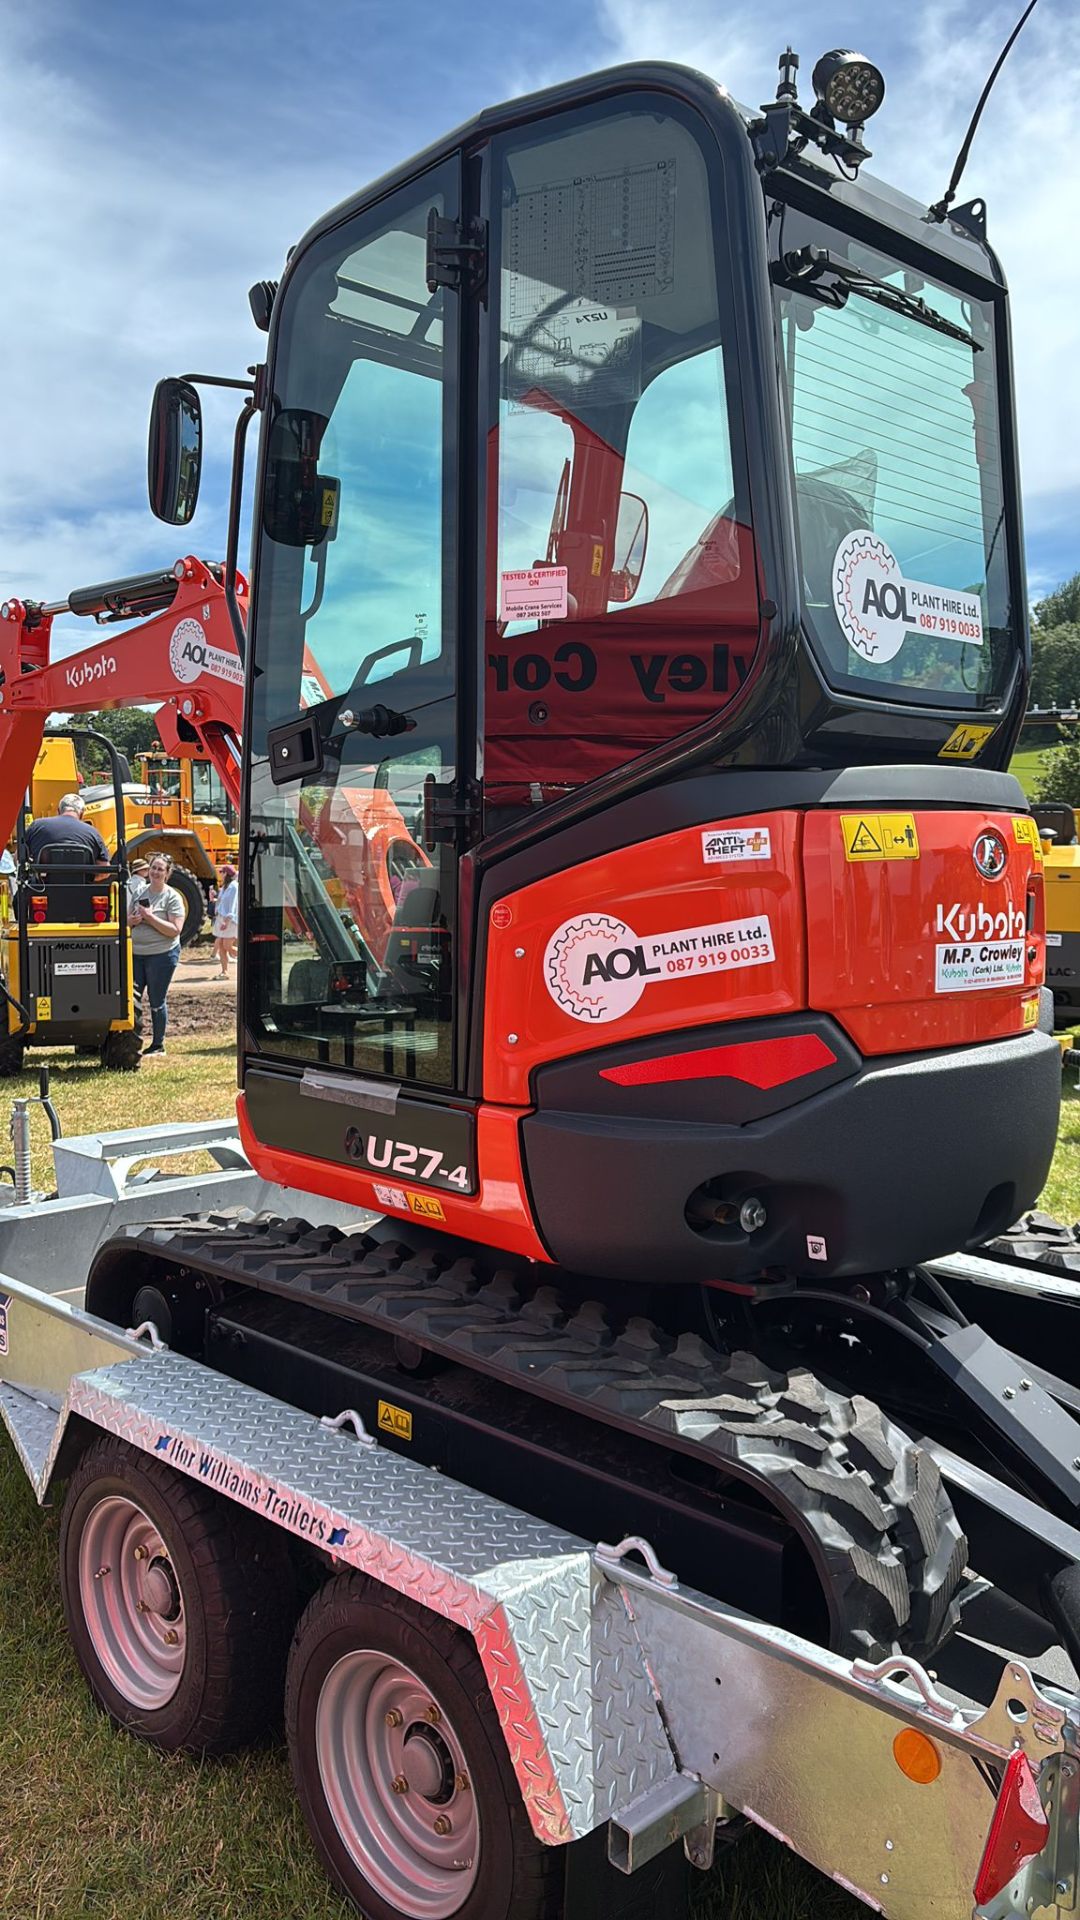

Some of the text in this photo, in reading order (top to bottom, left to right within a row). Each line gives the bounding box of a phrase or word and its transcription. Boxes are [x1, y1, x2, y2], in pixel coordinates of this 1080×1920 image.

[502, 569, 567, 581] TESTED & CERTIFIED
[528, 579, 539, 587] ON
[505, 602, 562, 612] Mobile Crane Services
[862, 578, 916, 624] AOL
[911, 591, 979, 618] PLANT HIRE Ltd.
[920, 613, 981, 638] 087 919 0033
[182, 642, 209, 668] AOL
[208, 651, 226, 664] PLANT
[225, 658, 238, 669] HIRE
[66, 654, 117, 688] Kubota
[210, 663, 245, 682] 087 919 003
[705, 836, 737, 848] ANTI
[705, 844, 746, 856] THEFT
[936, 901, 1026, 942] Kubota
[652, 926, 768, 957] PLANT HIRE Ltd.
[943, 944, 1023, 964] M.P. Crowley
[582, 945, 662, 986] AOL
[666, 944, 771, 973] 087 919 0033
[942, 967, 968, 978] Kubota
[972, 965, 992, 976] (Cork)
[1046, 967, 1071, 977] LAC
[366, 1135, 469, 1188] U27-4
[169, 1438, 328, 1540] Ifor Williams Trailers
